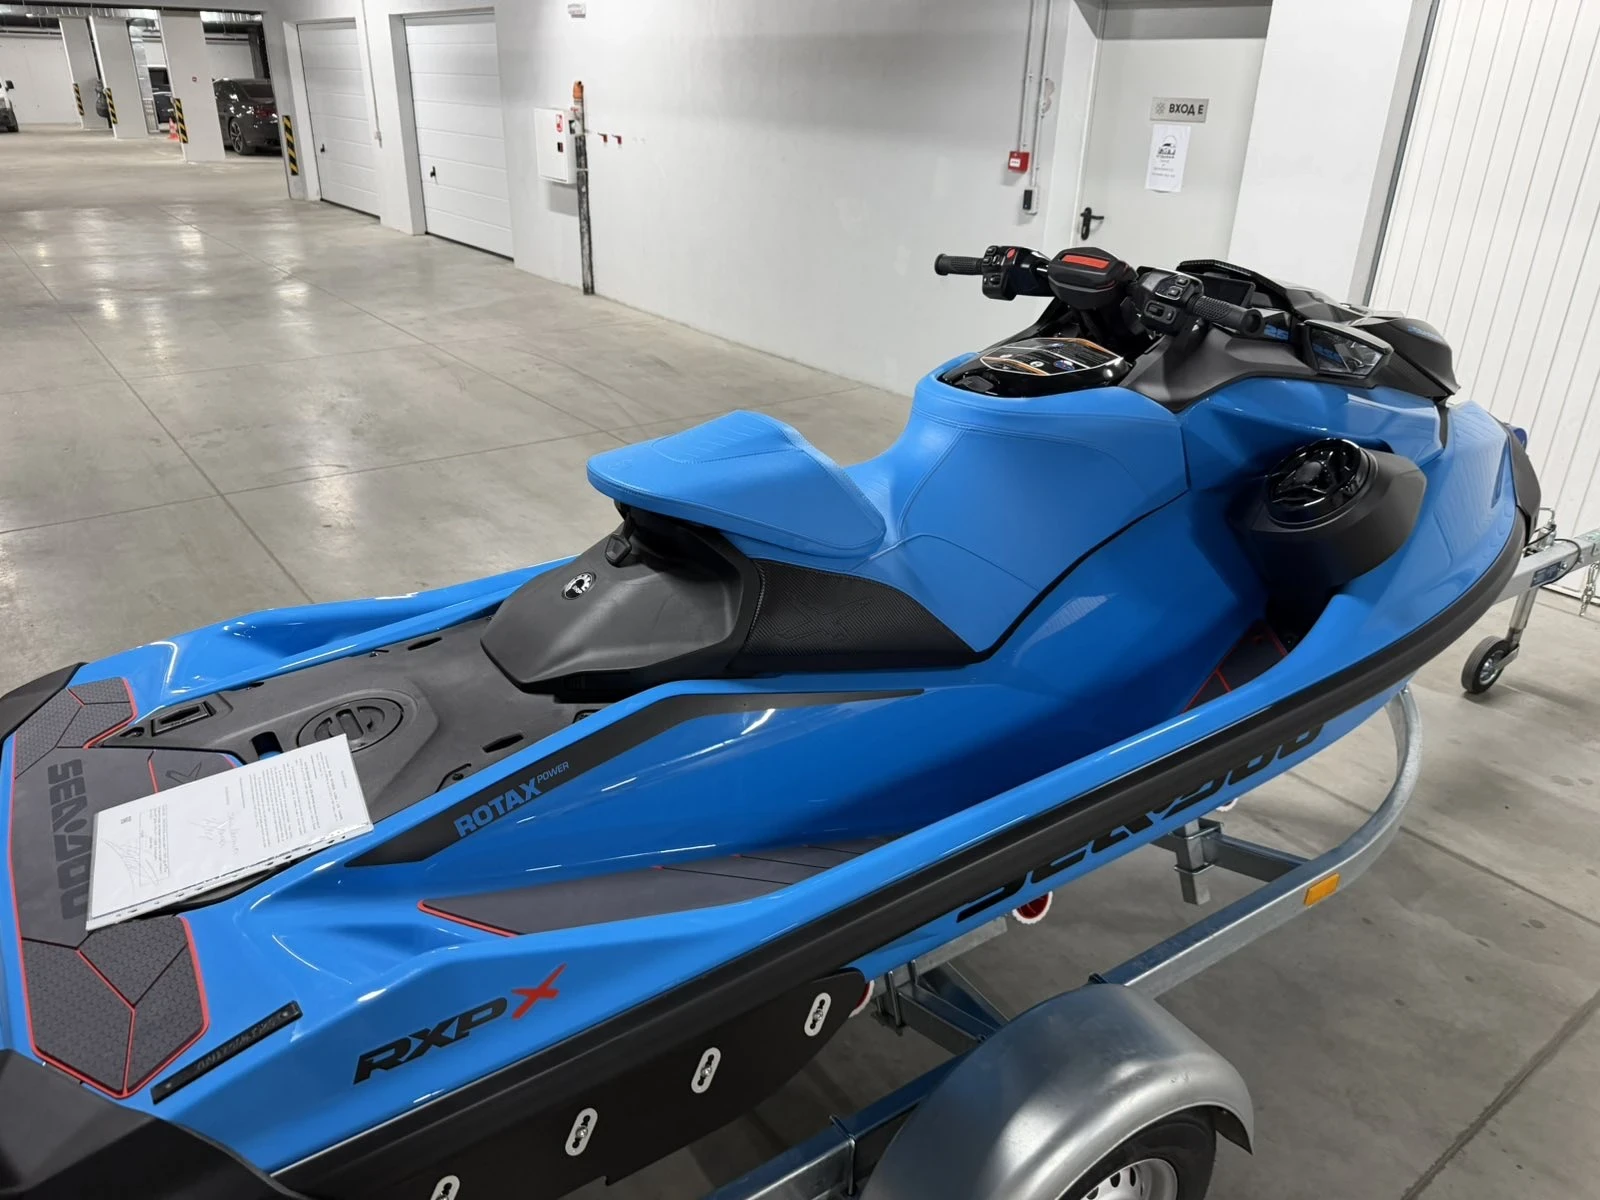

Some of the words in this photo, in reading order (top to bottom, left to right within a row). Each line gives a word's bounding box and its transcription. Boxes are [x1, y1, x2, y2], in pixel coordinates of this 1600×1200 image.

[1169, 103, 1195, 116] ВХОД
[454, 778, 541, 837] ROTAX
[536, 761, 570, 784] POWER
